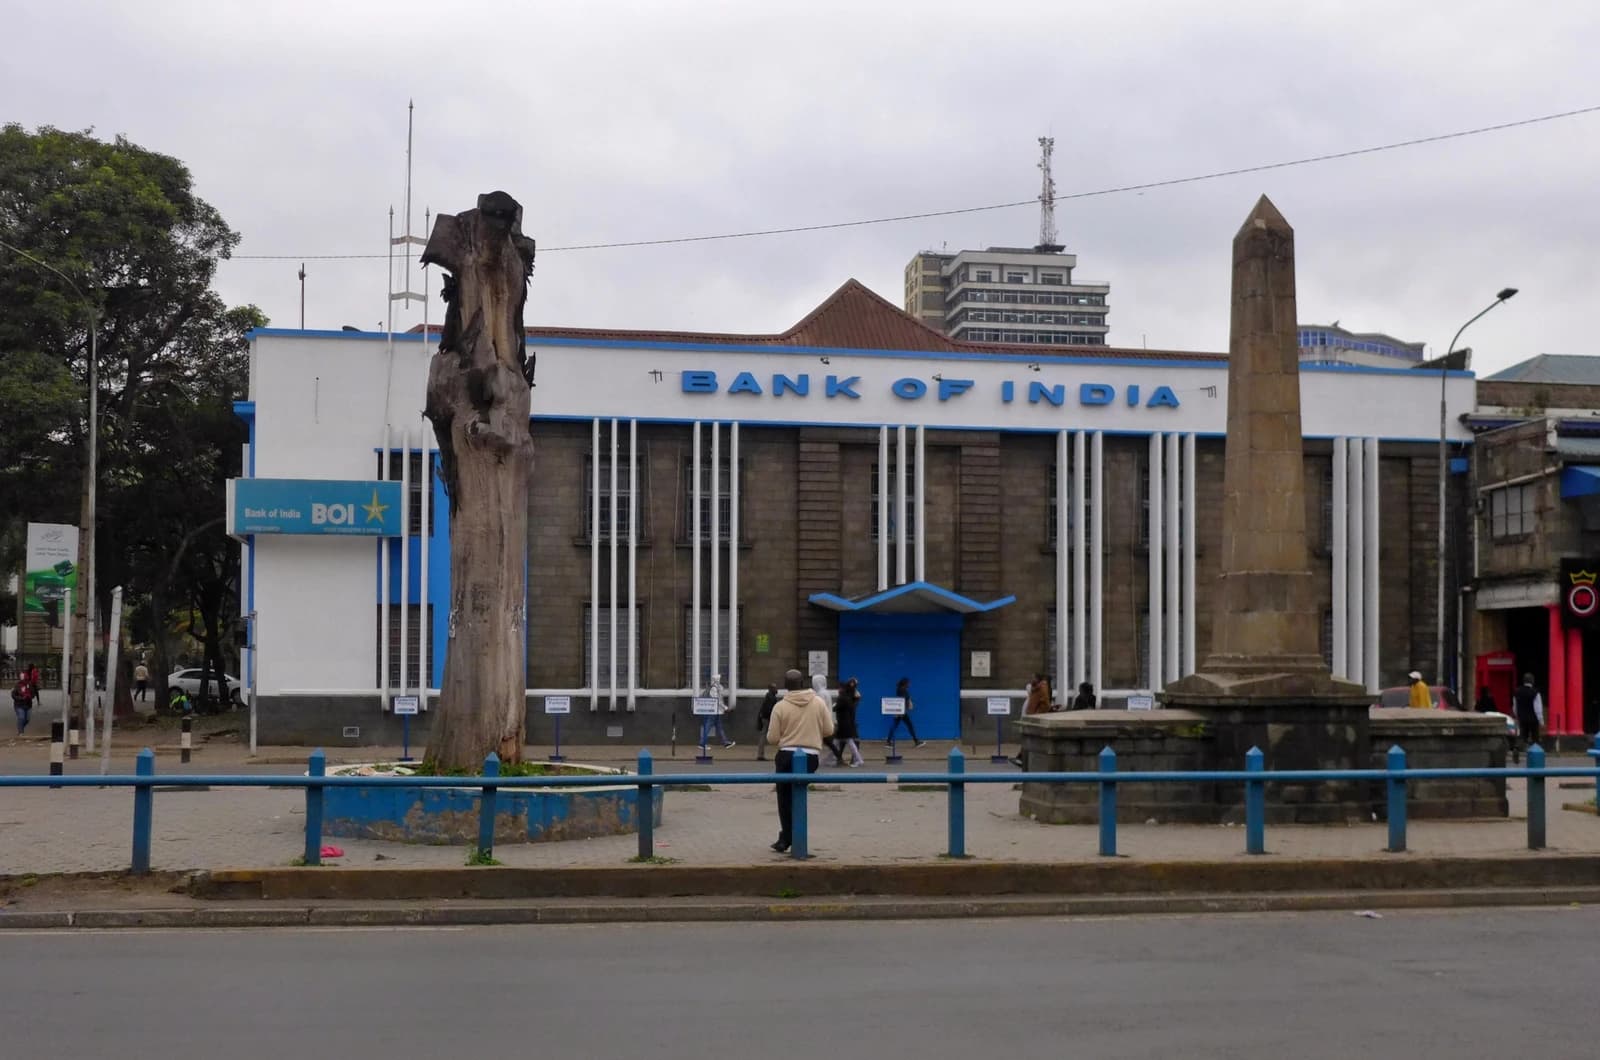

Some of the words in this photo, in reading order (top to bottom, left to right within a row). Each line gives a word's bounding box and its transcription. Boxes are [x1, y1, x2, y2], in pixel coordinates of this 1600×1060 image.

[682, 370, 861, 399] BANK
[892, 377, 974, 403] OF
[1001, 380, 1180, 408] INDIA
[244, 508, 266, 518] Bank
[268, 508, 278, 518] of
[280, 509, 301, 519] India
[311, 502, 355, 525] BOI
